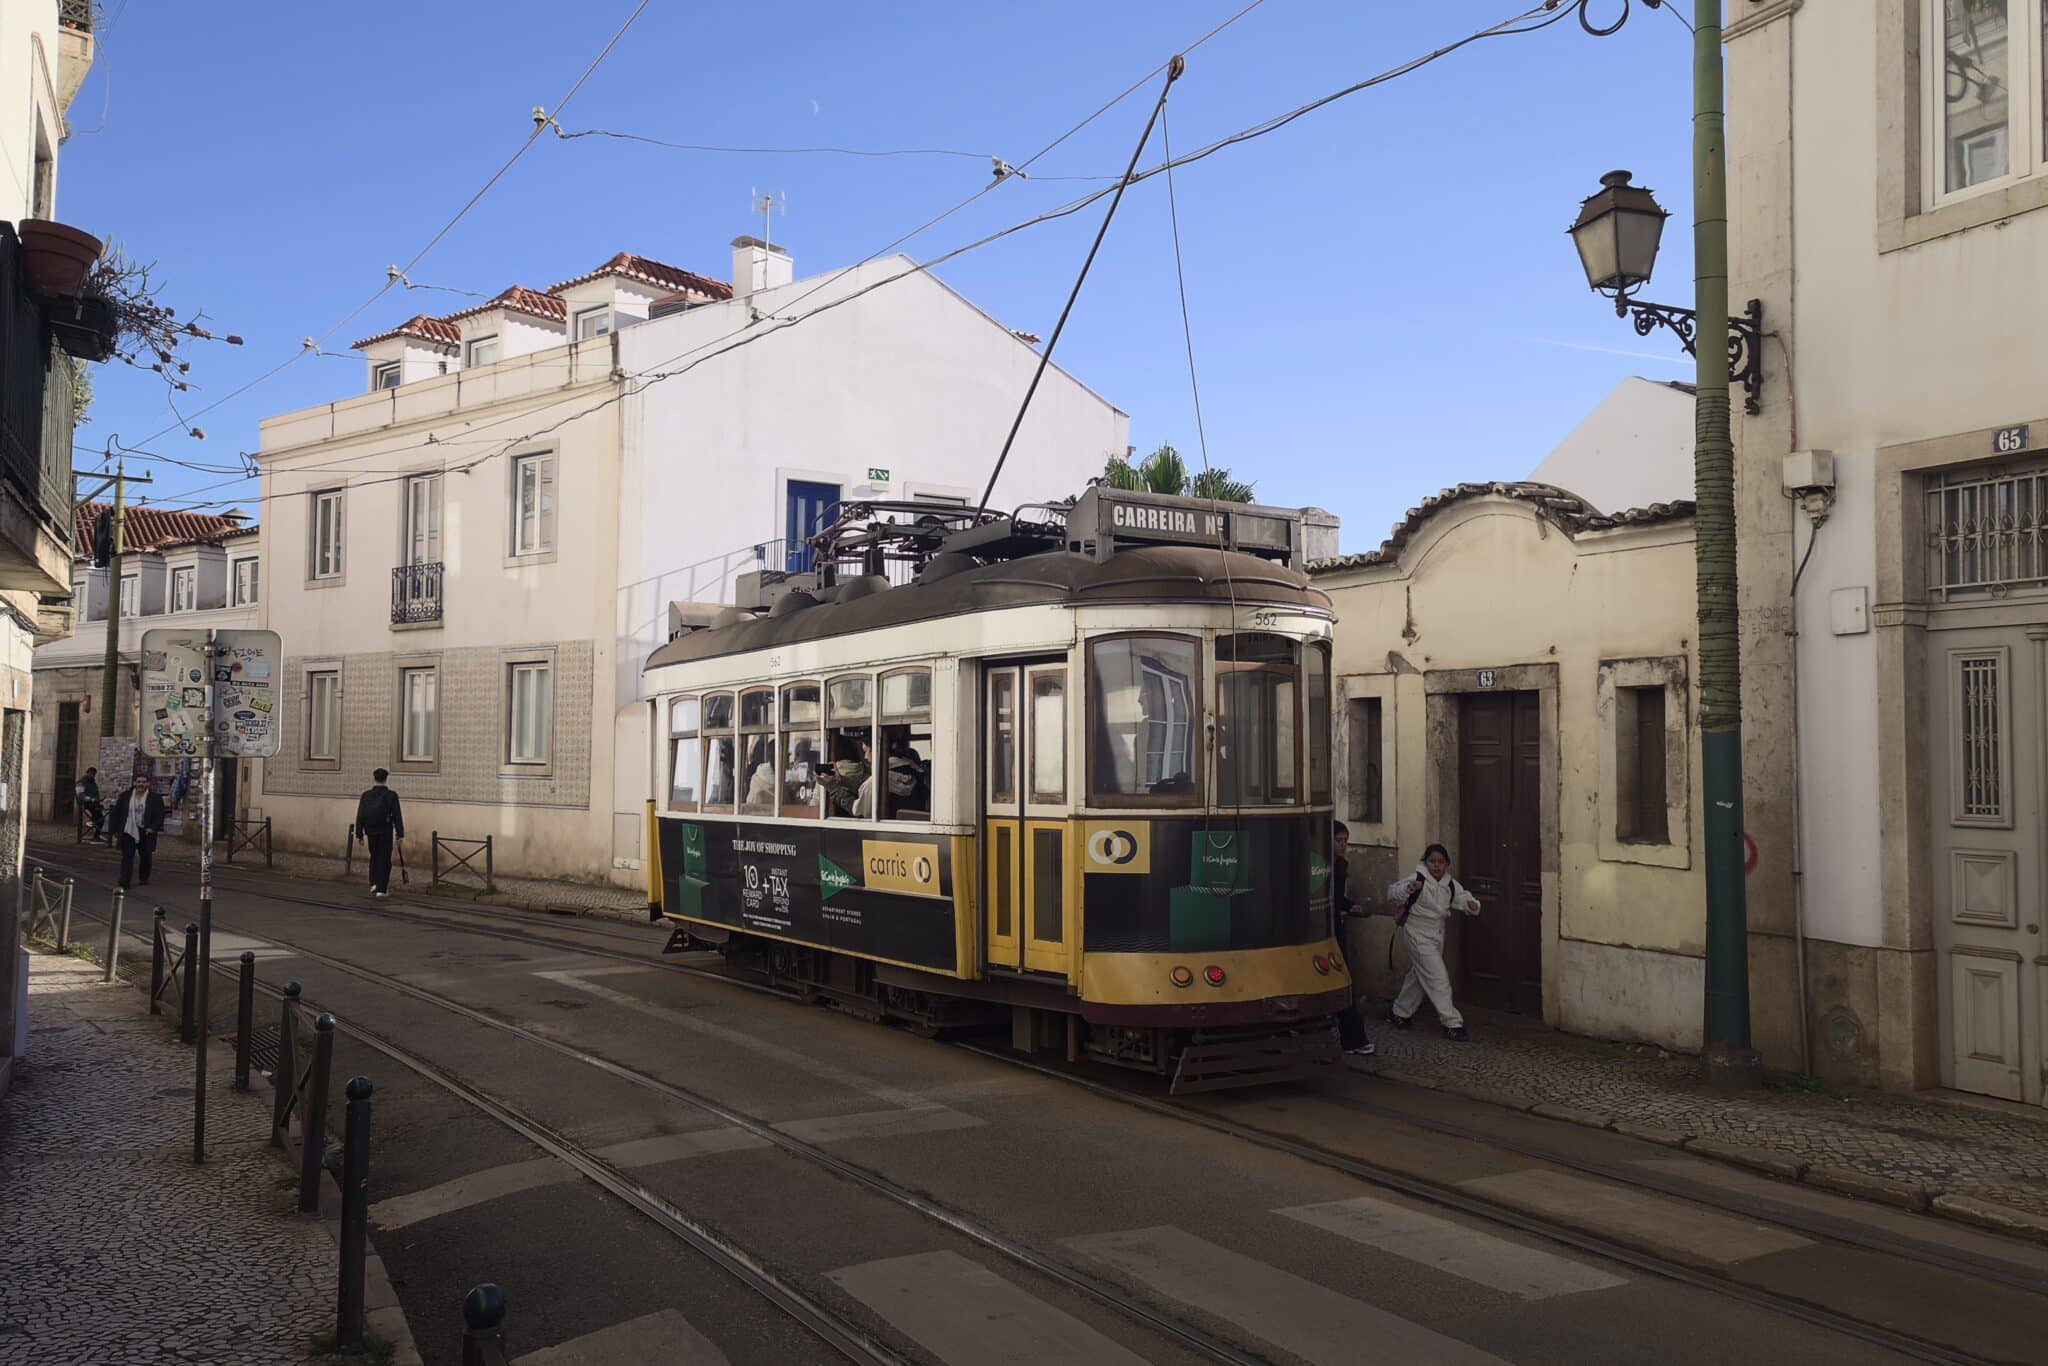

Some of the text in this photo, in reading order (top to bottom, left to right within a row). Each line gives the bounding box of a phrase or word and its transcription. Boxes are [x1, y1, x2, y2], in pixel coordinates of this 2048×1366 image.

[1999, 428, 2021, 451] 65
[1113, 505, 1196, 533] CARREIRA
[1255, 612, 1277, 626] 562
[1480, 671, 1493, 686] 63
[732, 840, 744, 850] THE
[756, 842, 764, 852] OF
[765, 843, 796, 856] SHOPPING
[870, 853, 906, 877] carris
[769, 876, 790, 897] TAX
